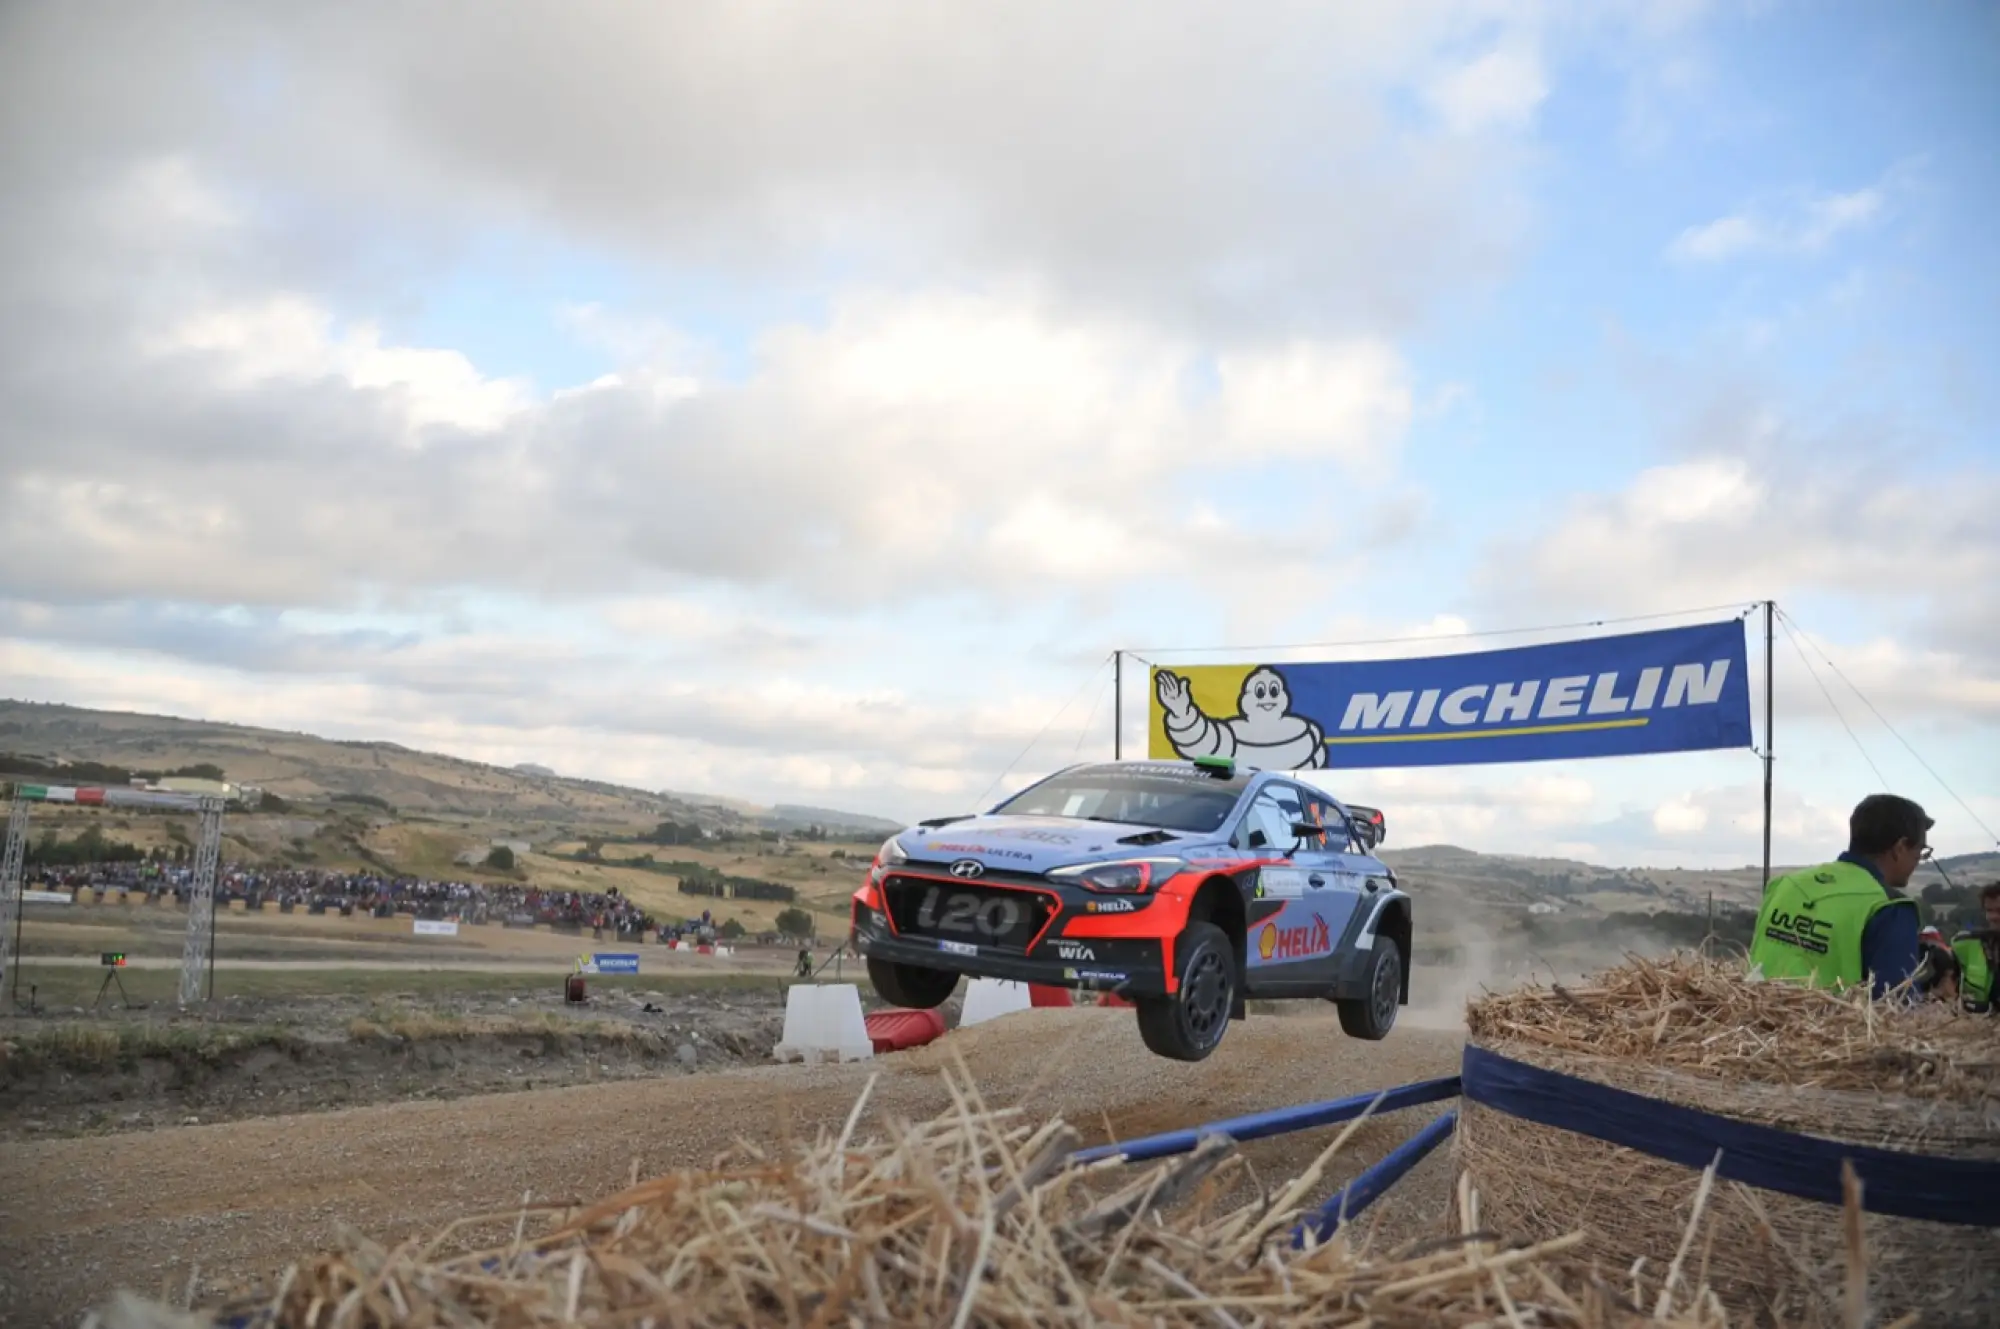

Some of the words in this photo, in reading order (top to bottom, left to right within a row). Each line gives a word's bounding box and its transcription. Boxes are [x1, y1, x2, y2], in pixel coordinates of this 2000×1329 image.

[1339, 659, 1730, 730] MICHELIN
[987, 848, 1033, 863] ULTRA
[1097, 897, 1135, 913] HELIX
[1277, 911, 1331, 959] HELIX
[1770, 908, 1834, 942] WRC
